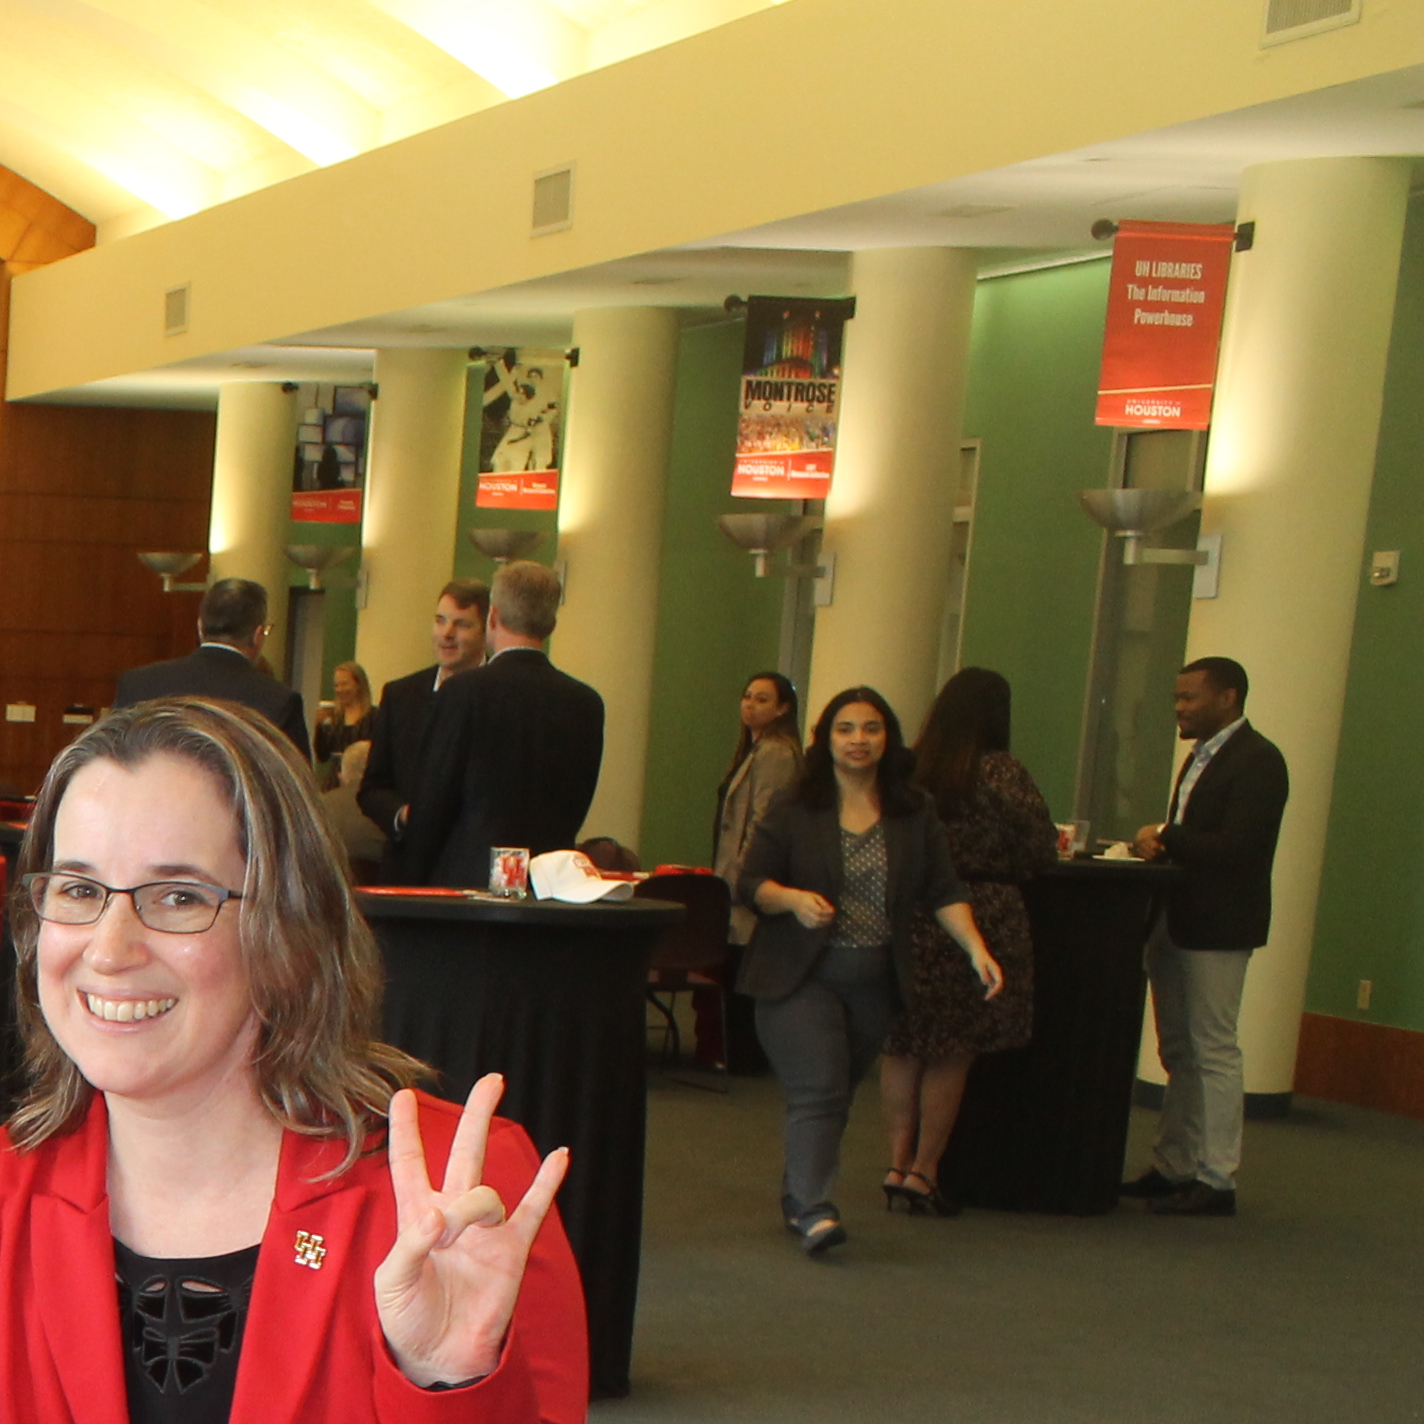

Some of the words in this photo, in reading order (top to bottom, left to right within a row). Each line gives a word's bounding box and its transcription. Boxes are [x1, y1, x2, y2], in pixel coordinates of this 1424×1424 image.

[1135, 260, 1150, 278] UH
[1152, 262, 1203, 280] LIBRARIES
[1126, 284, 1146, 300] The
[1147, 285, 1205, 304] Information
[1133, 308, 1194, 327] Powerhouse
[744, 380, 836, 403] MONTROSE
[1125, 405, 1181, 417] HOUSTON
[737, 464, 785, 476] HOUSTON
[479, 482, 517, 492] HOUSTON
